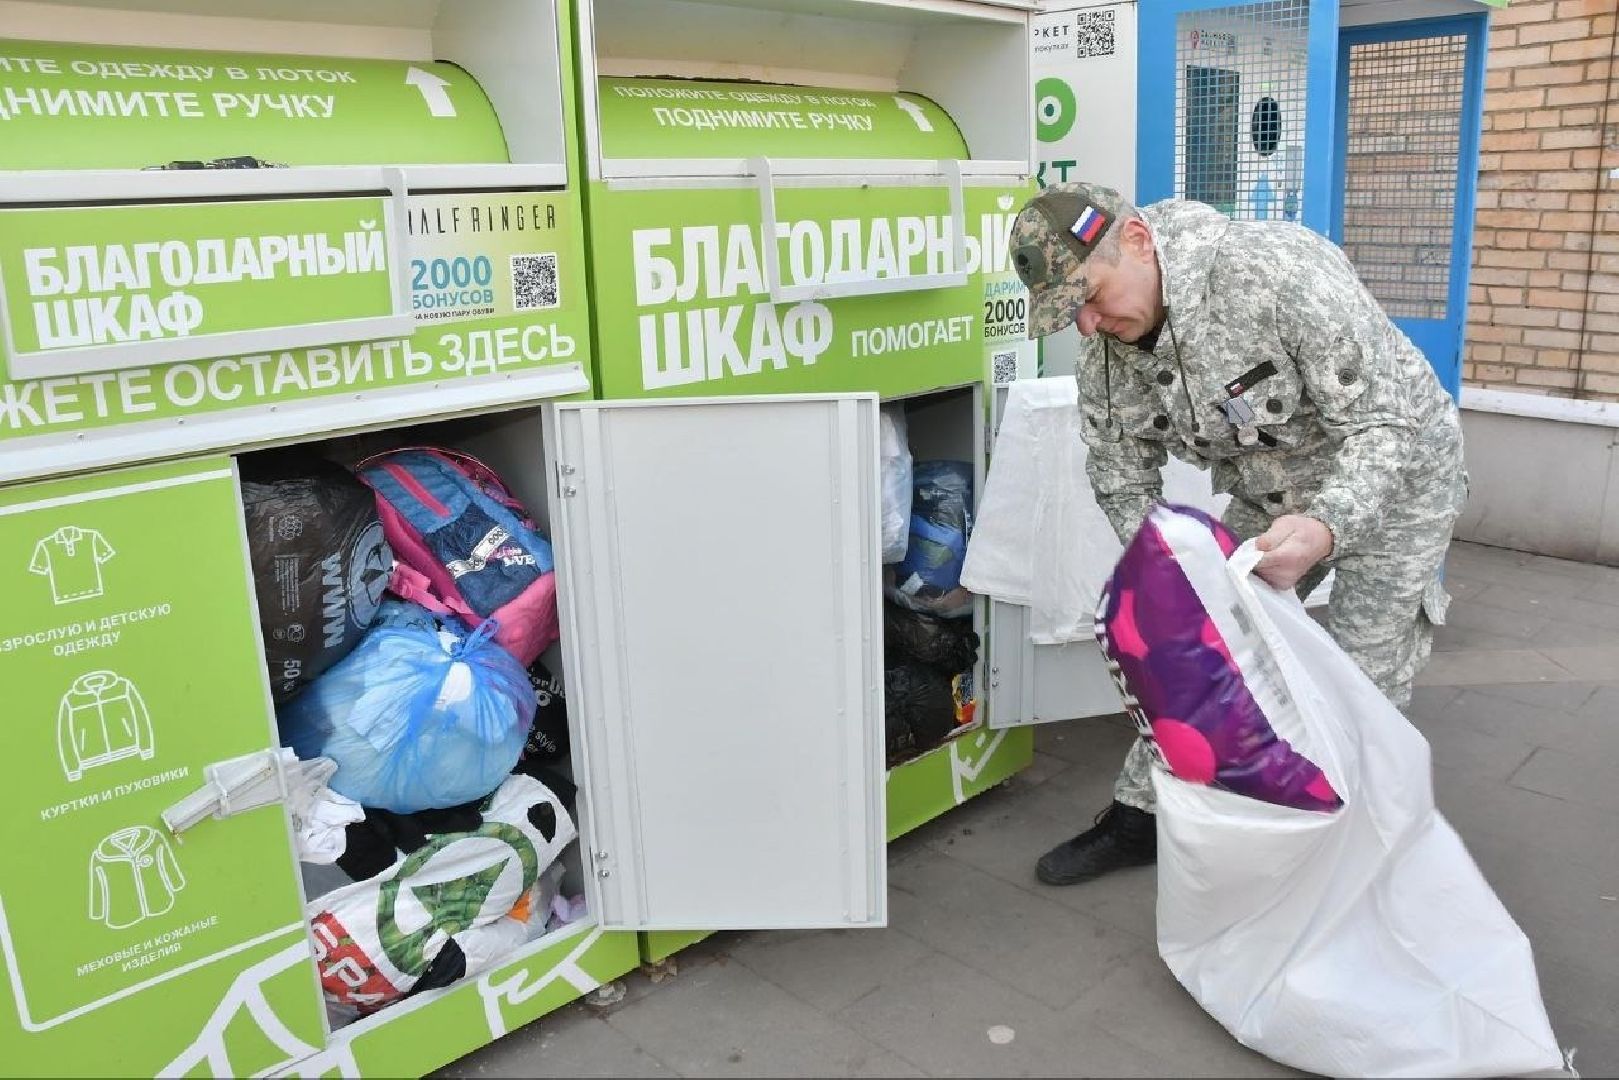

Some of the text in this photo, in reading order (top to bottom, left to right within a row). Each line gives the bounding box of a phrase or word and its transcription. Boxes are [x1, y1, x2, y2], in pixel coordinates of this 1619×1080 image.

[71, 60, 213, 81] ОДЕЖДУ
[225, 67, 249, 80] В
[256, 68, 357, 83] ЛОТОК
[0, 87, 334, 121] НИМИТЕ РУЧКУ
[613, 86, 728, 100] ПОЛОЖИТЕ
[728, 91, 801, 104] ОДЕЖДУ
[804, 95, 820, 104] В
[652, 107, 872, 131] ПОДНИМИТЕ РУЧКУ
[24, 220, 386, 296] БЛАГОДАРНЫЙ
[411, 255, 493, 290] 2000
[413, 289, 494, 309] БОНУСОВ
[984, 298, 1025, 323] 2000
[33, 291, 204, 350] ШКАФ
[851, 316, 973, 358] ПОМОГАЕТ
[984, 322, 1026, 338] БОНУСОВ
[639, 300, 834, 391] ШКАФ
[164, 339, 432, 406] ОСТАВИТЬ
[440, 324, 576, 377] ЗДЕСЬ
[0, 603, 172, 652] ЗРОСЛУЮ И ДЕТСКУЮ
[53, 631, 121, 657] ОДЕЖДУ
[40, 766, 189, 821] КУРТКИ И ПУХОВИКИ
[76, 915, 219, 977] МЕХОВЫЕ И КОЖАНЫЕ
[121, 942, 181, 972] ИЗДЕЛИЯ
